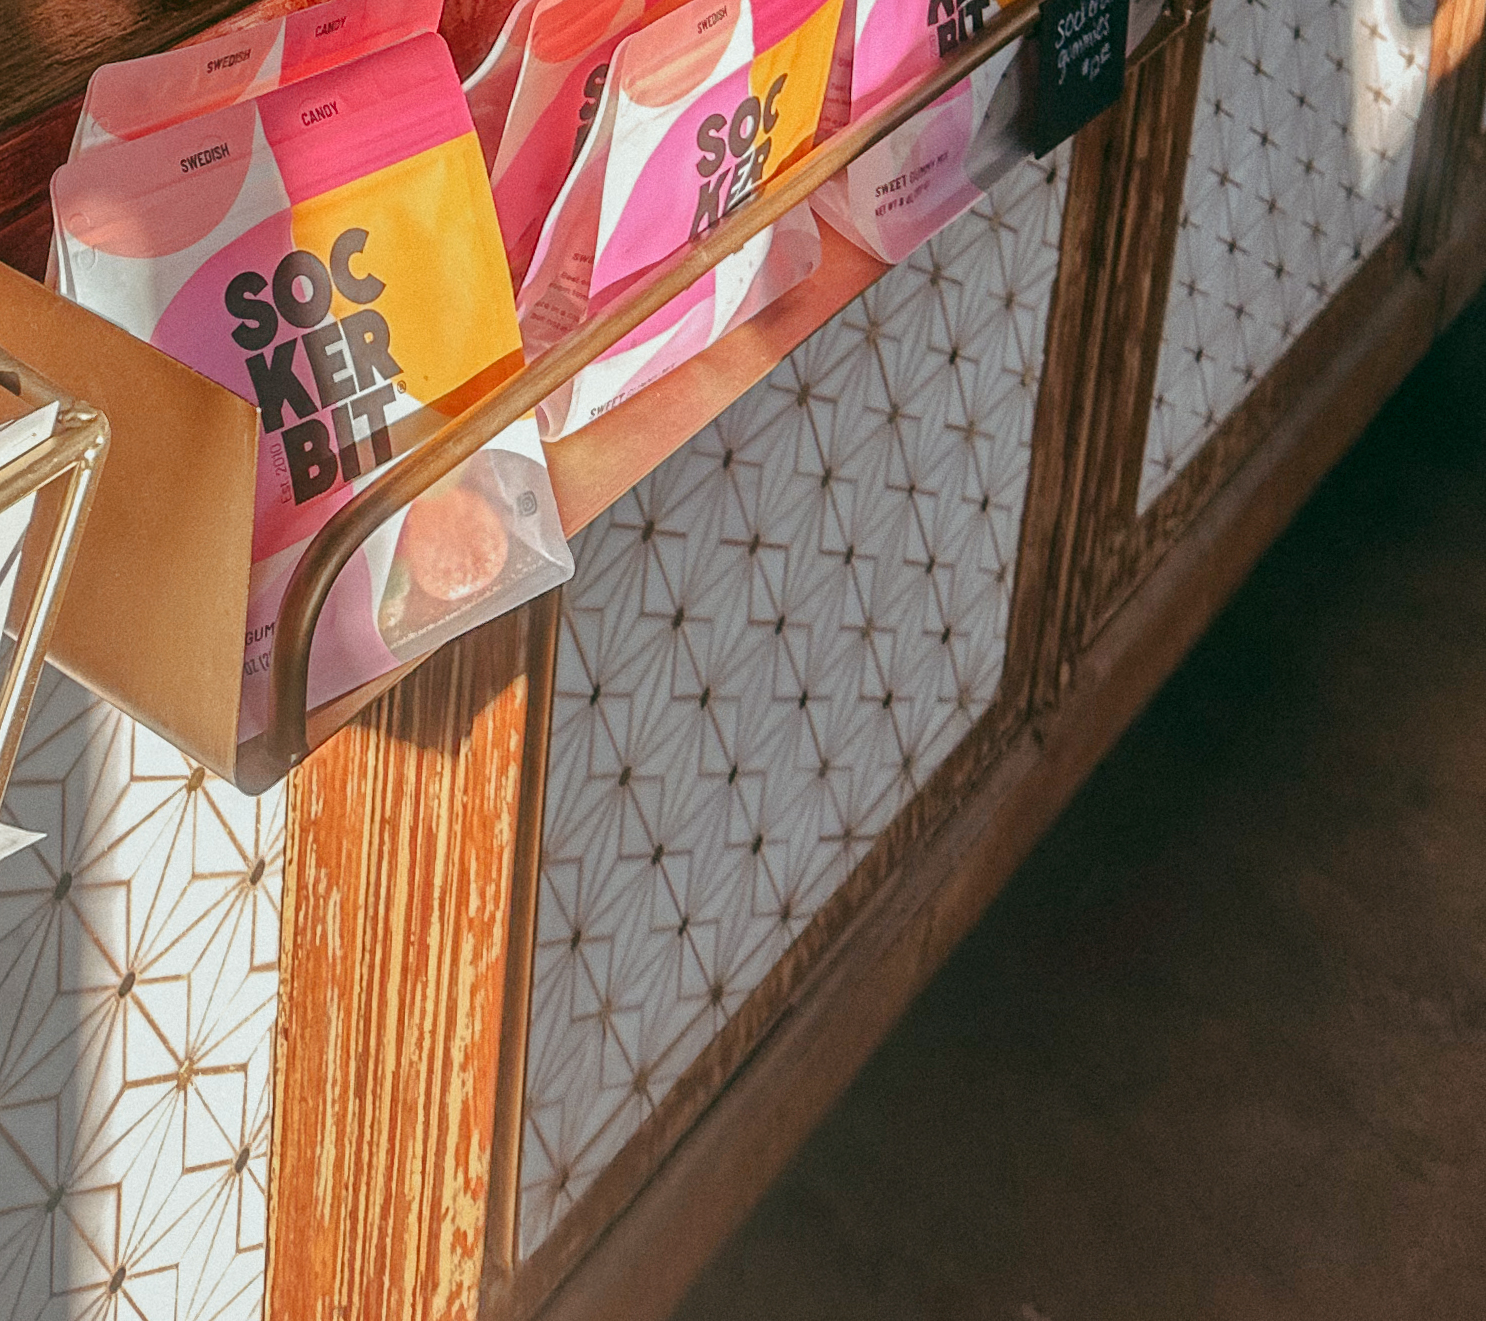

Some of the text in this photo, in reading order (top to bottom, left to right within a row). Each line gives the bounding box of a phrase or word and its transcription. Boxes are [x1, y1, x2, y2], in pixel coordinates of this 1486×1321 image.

[206, 15, 347, 74] SWEDISH CANDY
[697, 5, 728, 35] SWEDISH
[180, 100, 340, 173] SWEDISH CANDY
[696, 72, 788, 178] SOC
[875, 174, 907, 198] SWEET
[225, 228, 387, 352] SOC
[245, 309, 404, 434] KER
[269, 442, 289, 477] 2010
[281, 382, 394, 506] BIT
